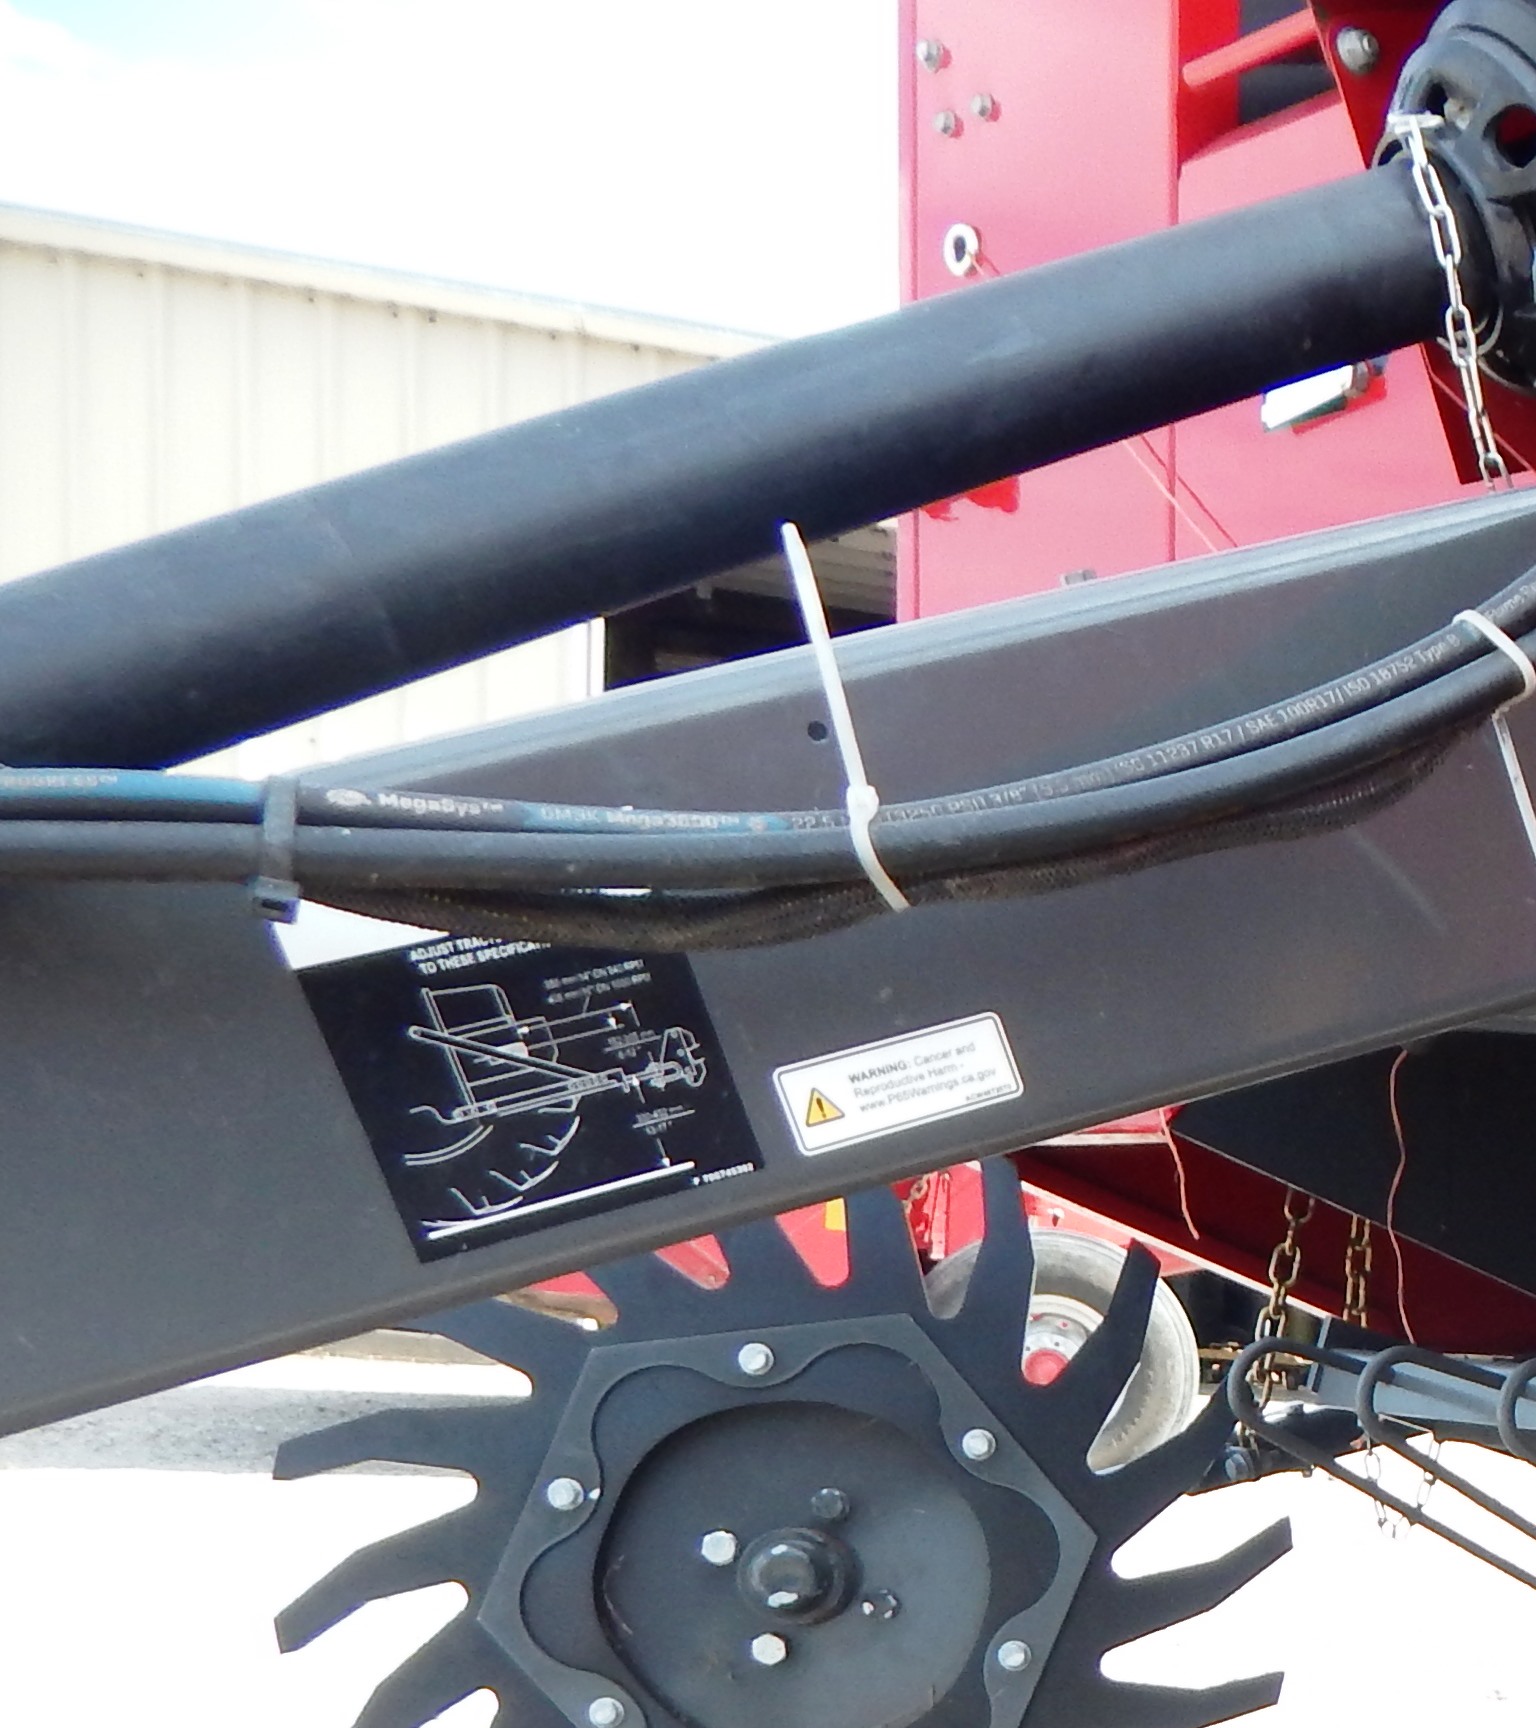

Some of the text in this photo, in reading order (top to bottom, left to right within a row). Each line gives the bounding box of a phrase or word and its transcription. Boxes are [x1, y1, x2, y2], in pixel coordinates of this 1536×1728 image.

[1201, 730, 1234, 751] R17
[1245, 716, 1279, 736] SAE
[1344, 677, 1372, 698] ISO
[410, 939, 455, 961] ADJUST
[417, 961, 438, 976] TO
[436, 953, 476, 972] THESE
[848, 1042, 976, 1084] WARNING: Cancer and
[854, 1074, 925, 1098] Reproductive
[927, 1063, 957, 1078] Harm
[860, 1068, 996, 1112] www.P65Warnings.ca.gov
